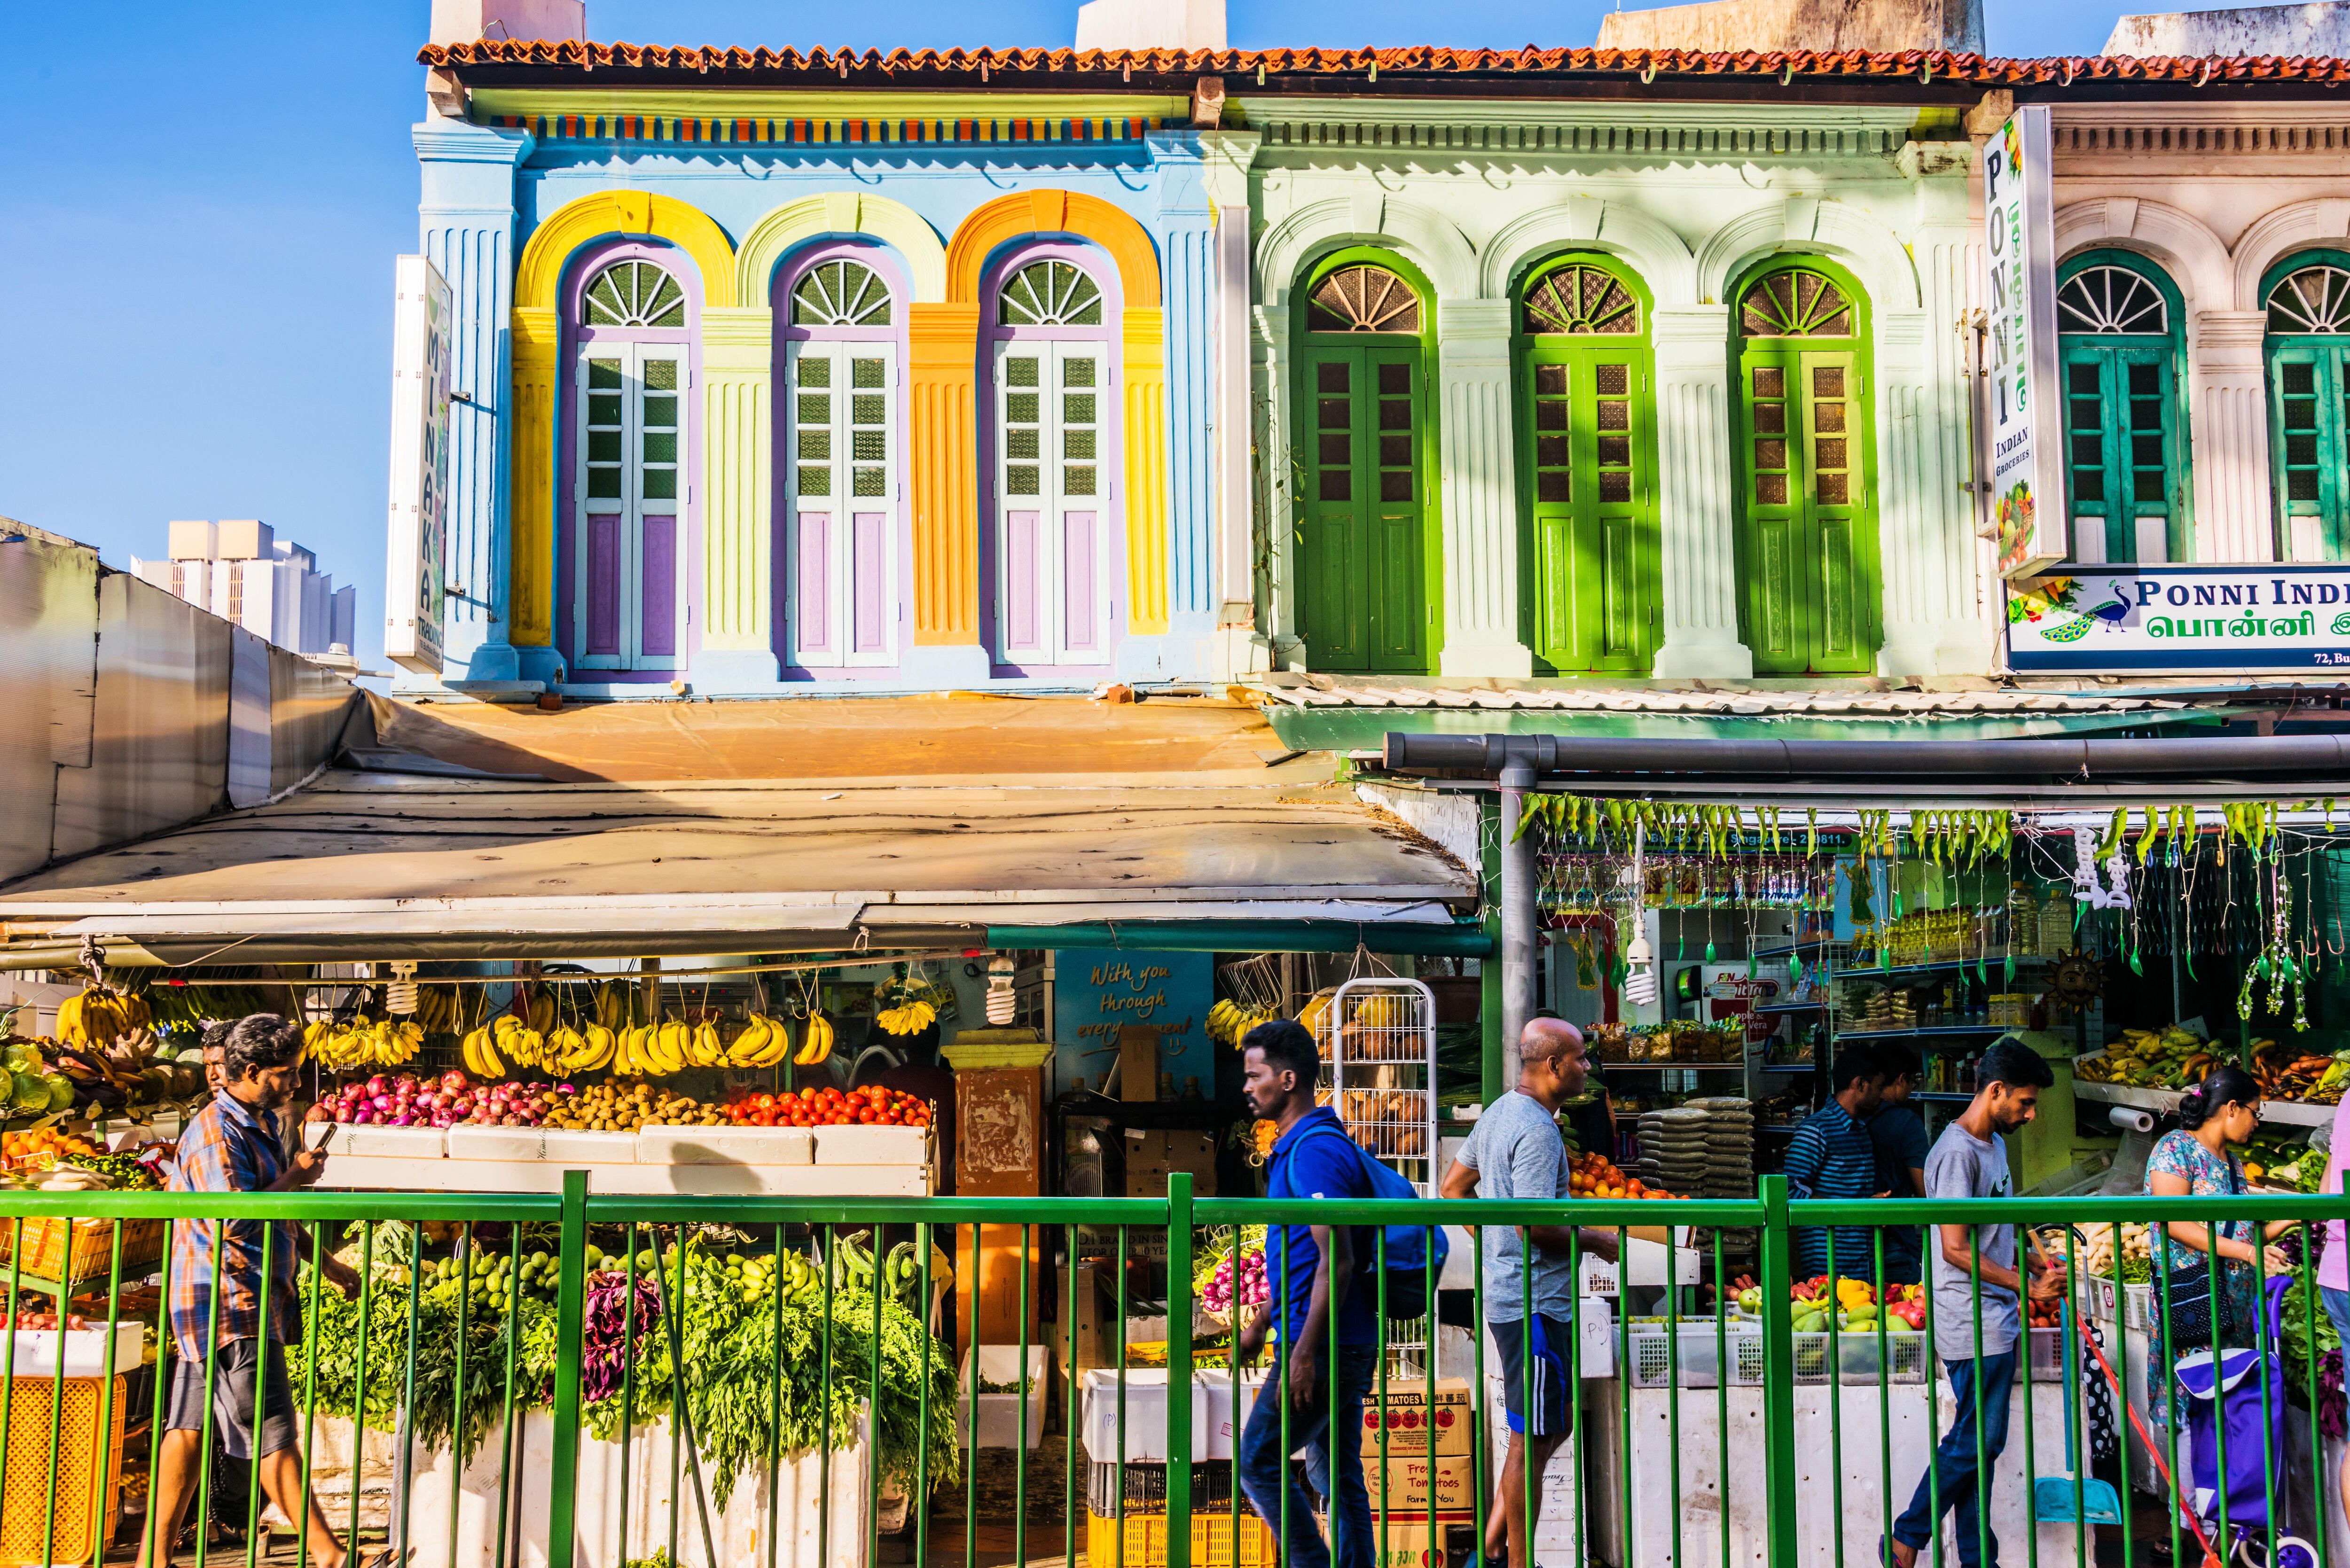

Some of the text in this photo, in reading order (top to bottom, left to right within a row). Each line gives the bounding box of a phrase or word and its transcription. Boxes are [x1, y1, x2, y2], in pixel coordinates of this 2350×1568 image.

[1988, 149, 2008, 426] PONNI
[1996, 426, 2028, 459] INDIAN
[420, 323, 439, 613] MINAKA
[1996, 449, 2029, 476] GROCERIES
[2134, 581, 2259, 607] PONNI
[417, 616, 443, 649] TRADING
[2146, 609, 2315, 638] பொன்னி
[2314, 653, 2332, 665] 72,
[1800, 834, 1845, 844] 29811.
[1090, 962, 1171, 991] With you
[1100, 988, 1167, 1018] through
[1099, 1235, 1136, 1245] BRAD
[1138, 1235, 1149, 1244] IN
[1376, 1395, 1419, 1405] TMATOES
[1407, 1477, 1459, 1488] Tomtoes
[1407, 1494, 1454, 1503] Farm You
